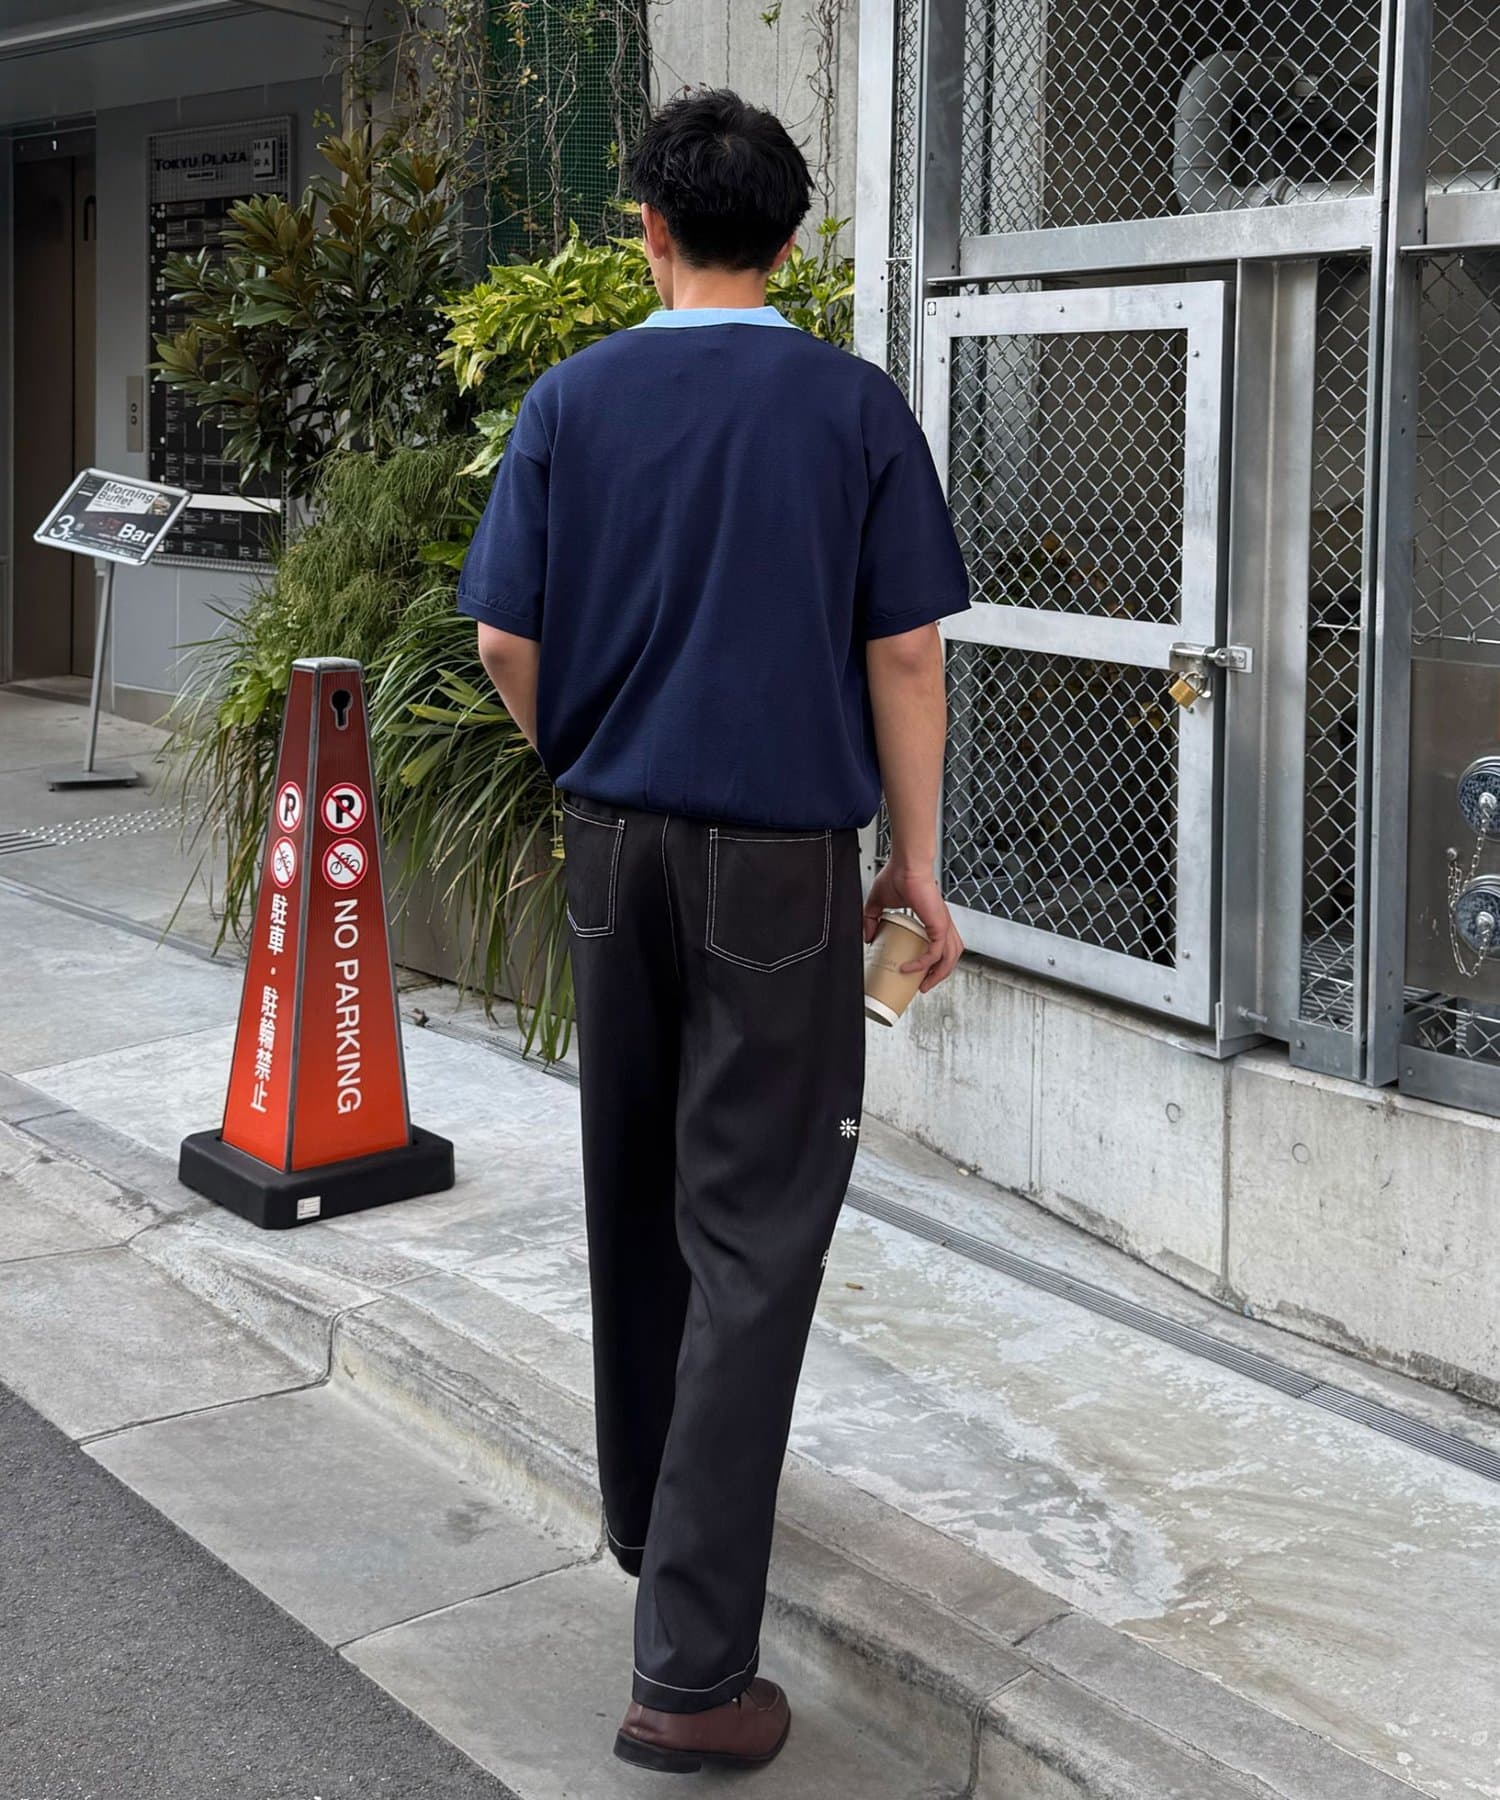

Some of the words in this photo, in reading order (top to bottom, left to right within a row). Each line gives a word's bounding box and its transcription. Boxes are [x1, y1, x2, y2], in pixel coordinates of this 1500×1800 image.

[154, 156, 198, 171] TOKYU
[202, 151, 247, 167] PLAZA
[97, 491, 134, 507] Buffet
[104, 482, 156, 504] Morning
[117, 523, 155, 544] Bar
[334, 899, 360, 949] NO
[335, 959, 362, 1114] PARKING
